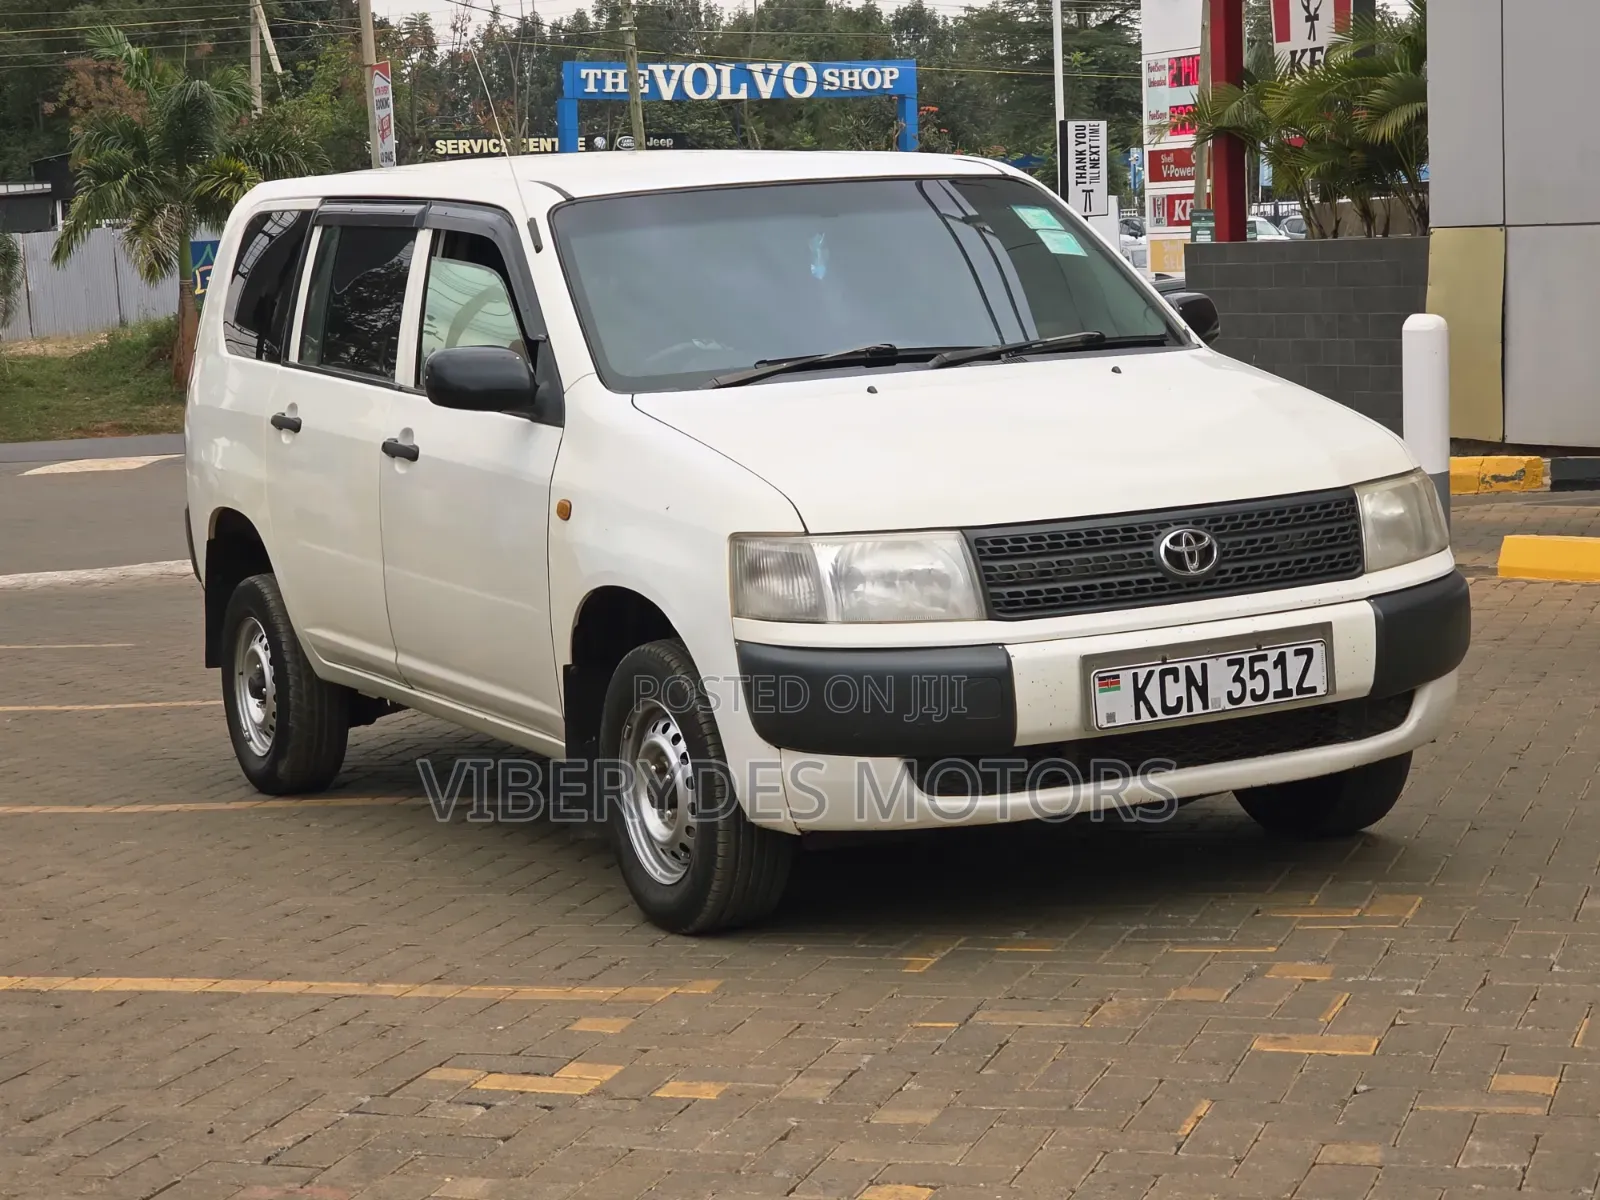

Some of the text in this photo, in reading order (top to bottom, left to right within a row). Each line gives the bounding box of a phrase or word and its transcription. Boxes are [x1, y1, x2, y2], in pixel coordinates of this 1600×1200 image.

[581, 63, 900, 100] THE VOLVO SHOP
[519, 137, 586, 152] ENTE
[646, 137, 674, 148] Jeep
[1075, 124, 1087, 187] THANK YOU
[1089, 123, 1101, 185] TILL NEXT TIME
[1161, 153, 1174, 164] Shell
[1173, 199, 1195, 221] KF
[1132, 662, 1210, 720] KCN
[1226, 647, 1317, 706] 351Z
